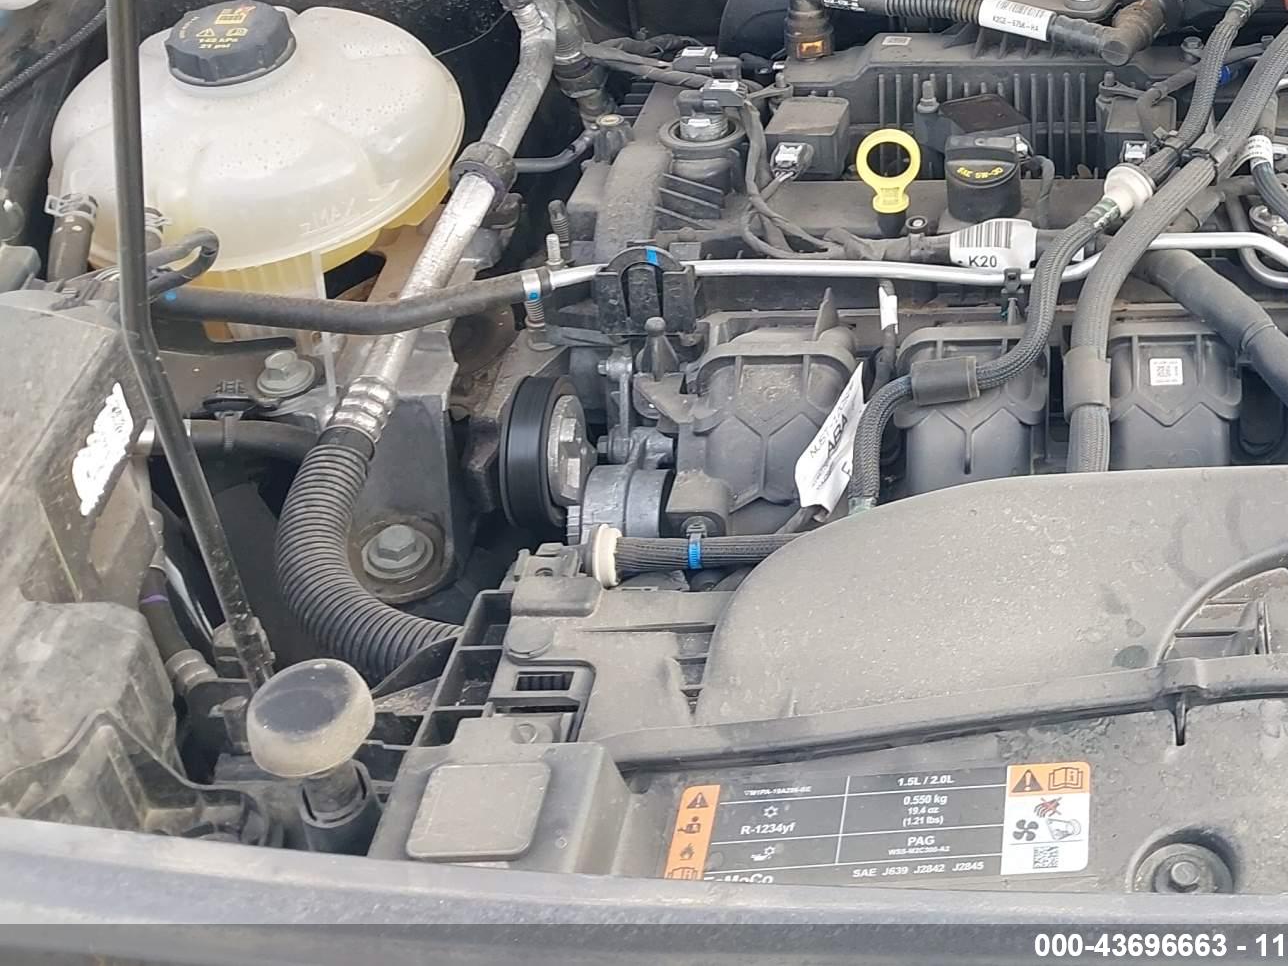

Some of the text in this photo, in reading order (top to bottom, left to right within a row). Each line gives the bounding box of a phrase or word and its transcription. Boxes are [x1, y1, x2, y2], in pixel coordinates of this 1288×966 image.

[968, 255, 998, 268] K20
[897, 776, 922, 787] 1.5L
[929, 774, 955, 785] 2.0L
[903, 794, 948, 806] 0.550 kg
[907, 807, 927, 815] 19.4
[902, 816, 944, 827] (1.21 lbs)
[740, 822, 796, 835] R-1234yf
[907, 835, 936, 846] PAG
[852, 861, 985, 878] SAE J639 J2842 J2845
